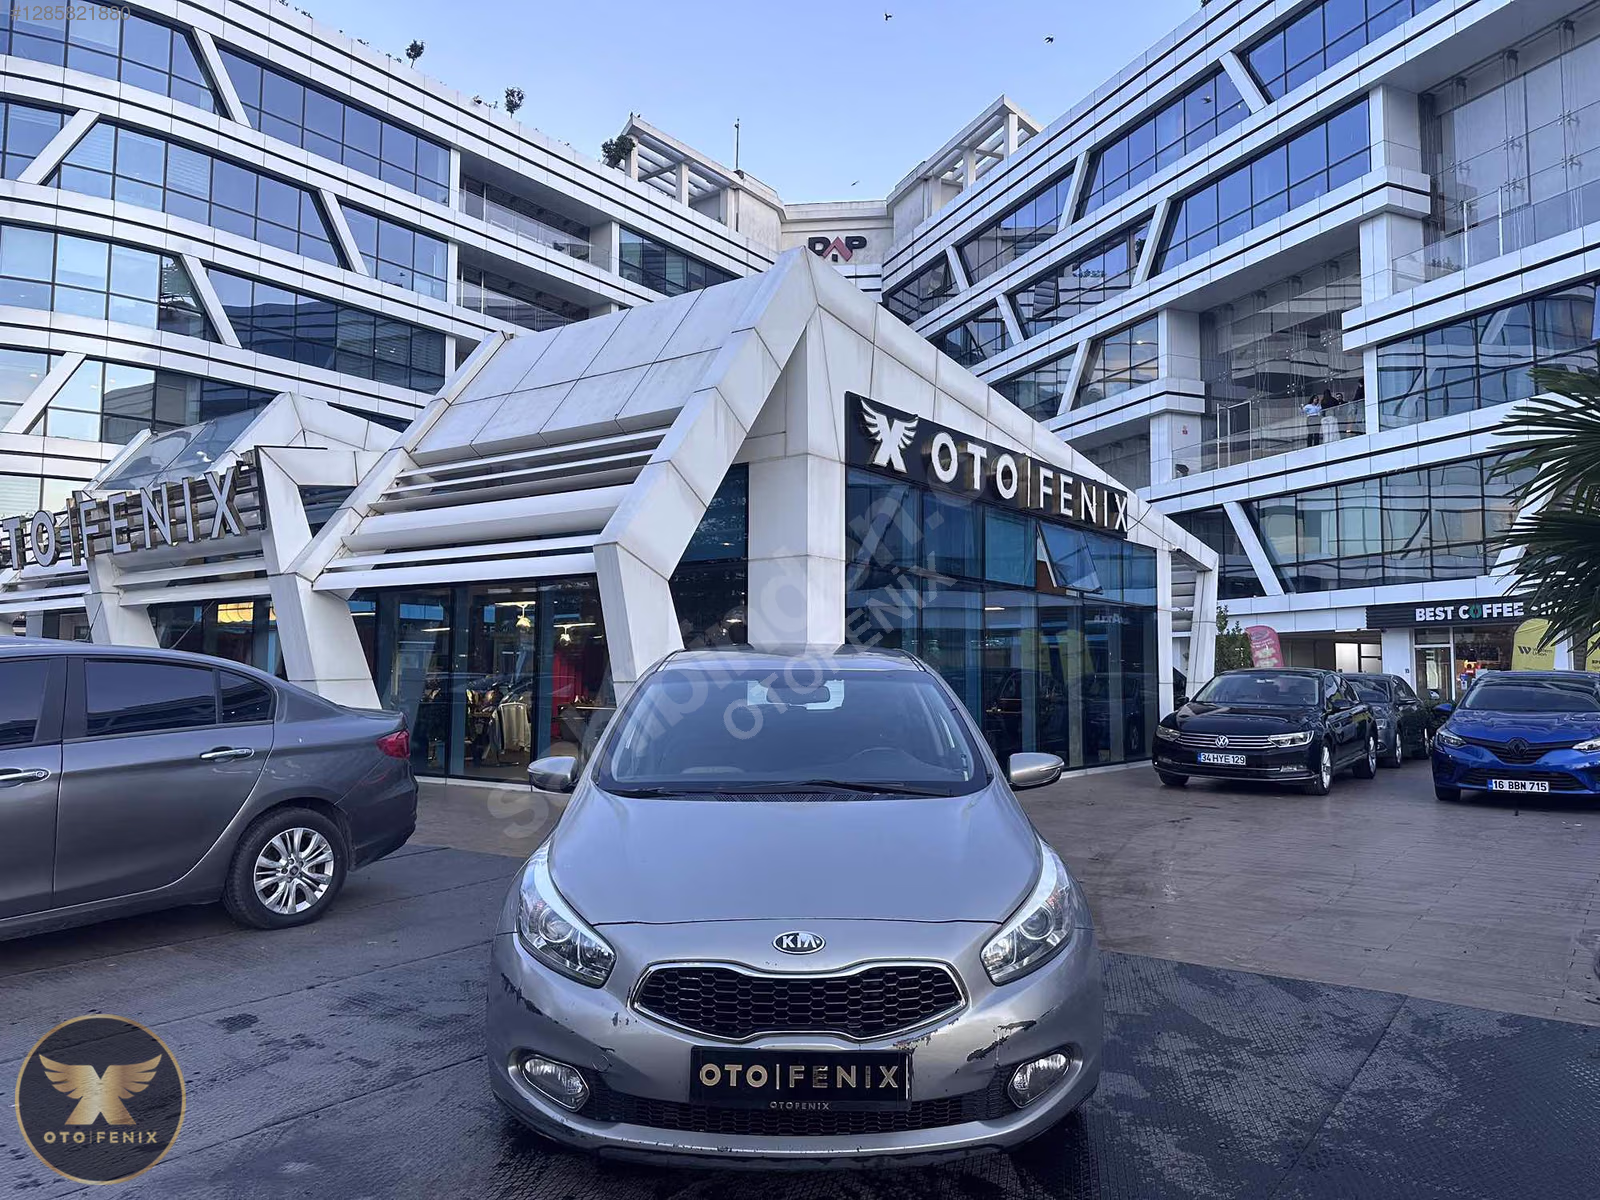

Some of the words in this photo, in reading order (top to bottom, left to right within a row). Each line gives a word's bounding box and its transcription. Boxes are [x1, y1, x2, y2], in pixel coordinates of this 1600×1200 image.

[1415, 605, 1454, 622] BEST
[1458, 602, 1524, 620] COFFEE
[1201, 753, 1211, 762] 34
[1212, 754, 1230, 763] HYE
[1231, 755, 1245, 764] 129
[1493, 780, 1504, 789] 16
[1508, 781, 1526, 790] BBN
[1529, 782, 1547, 792] 715
[782, 933, 817, 949] KIA
[769, 1101, 830, 1111] OTOFENIX
